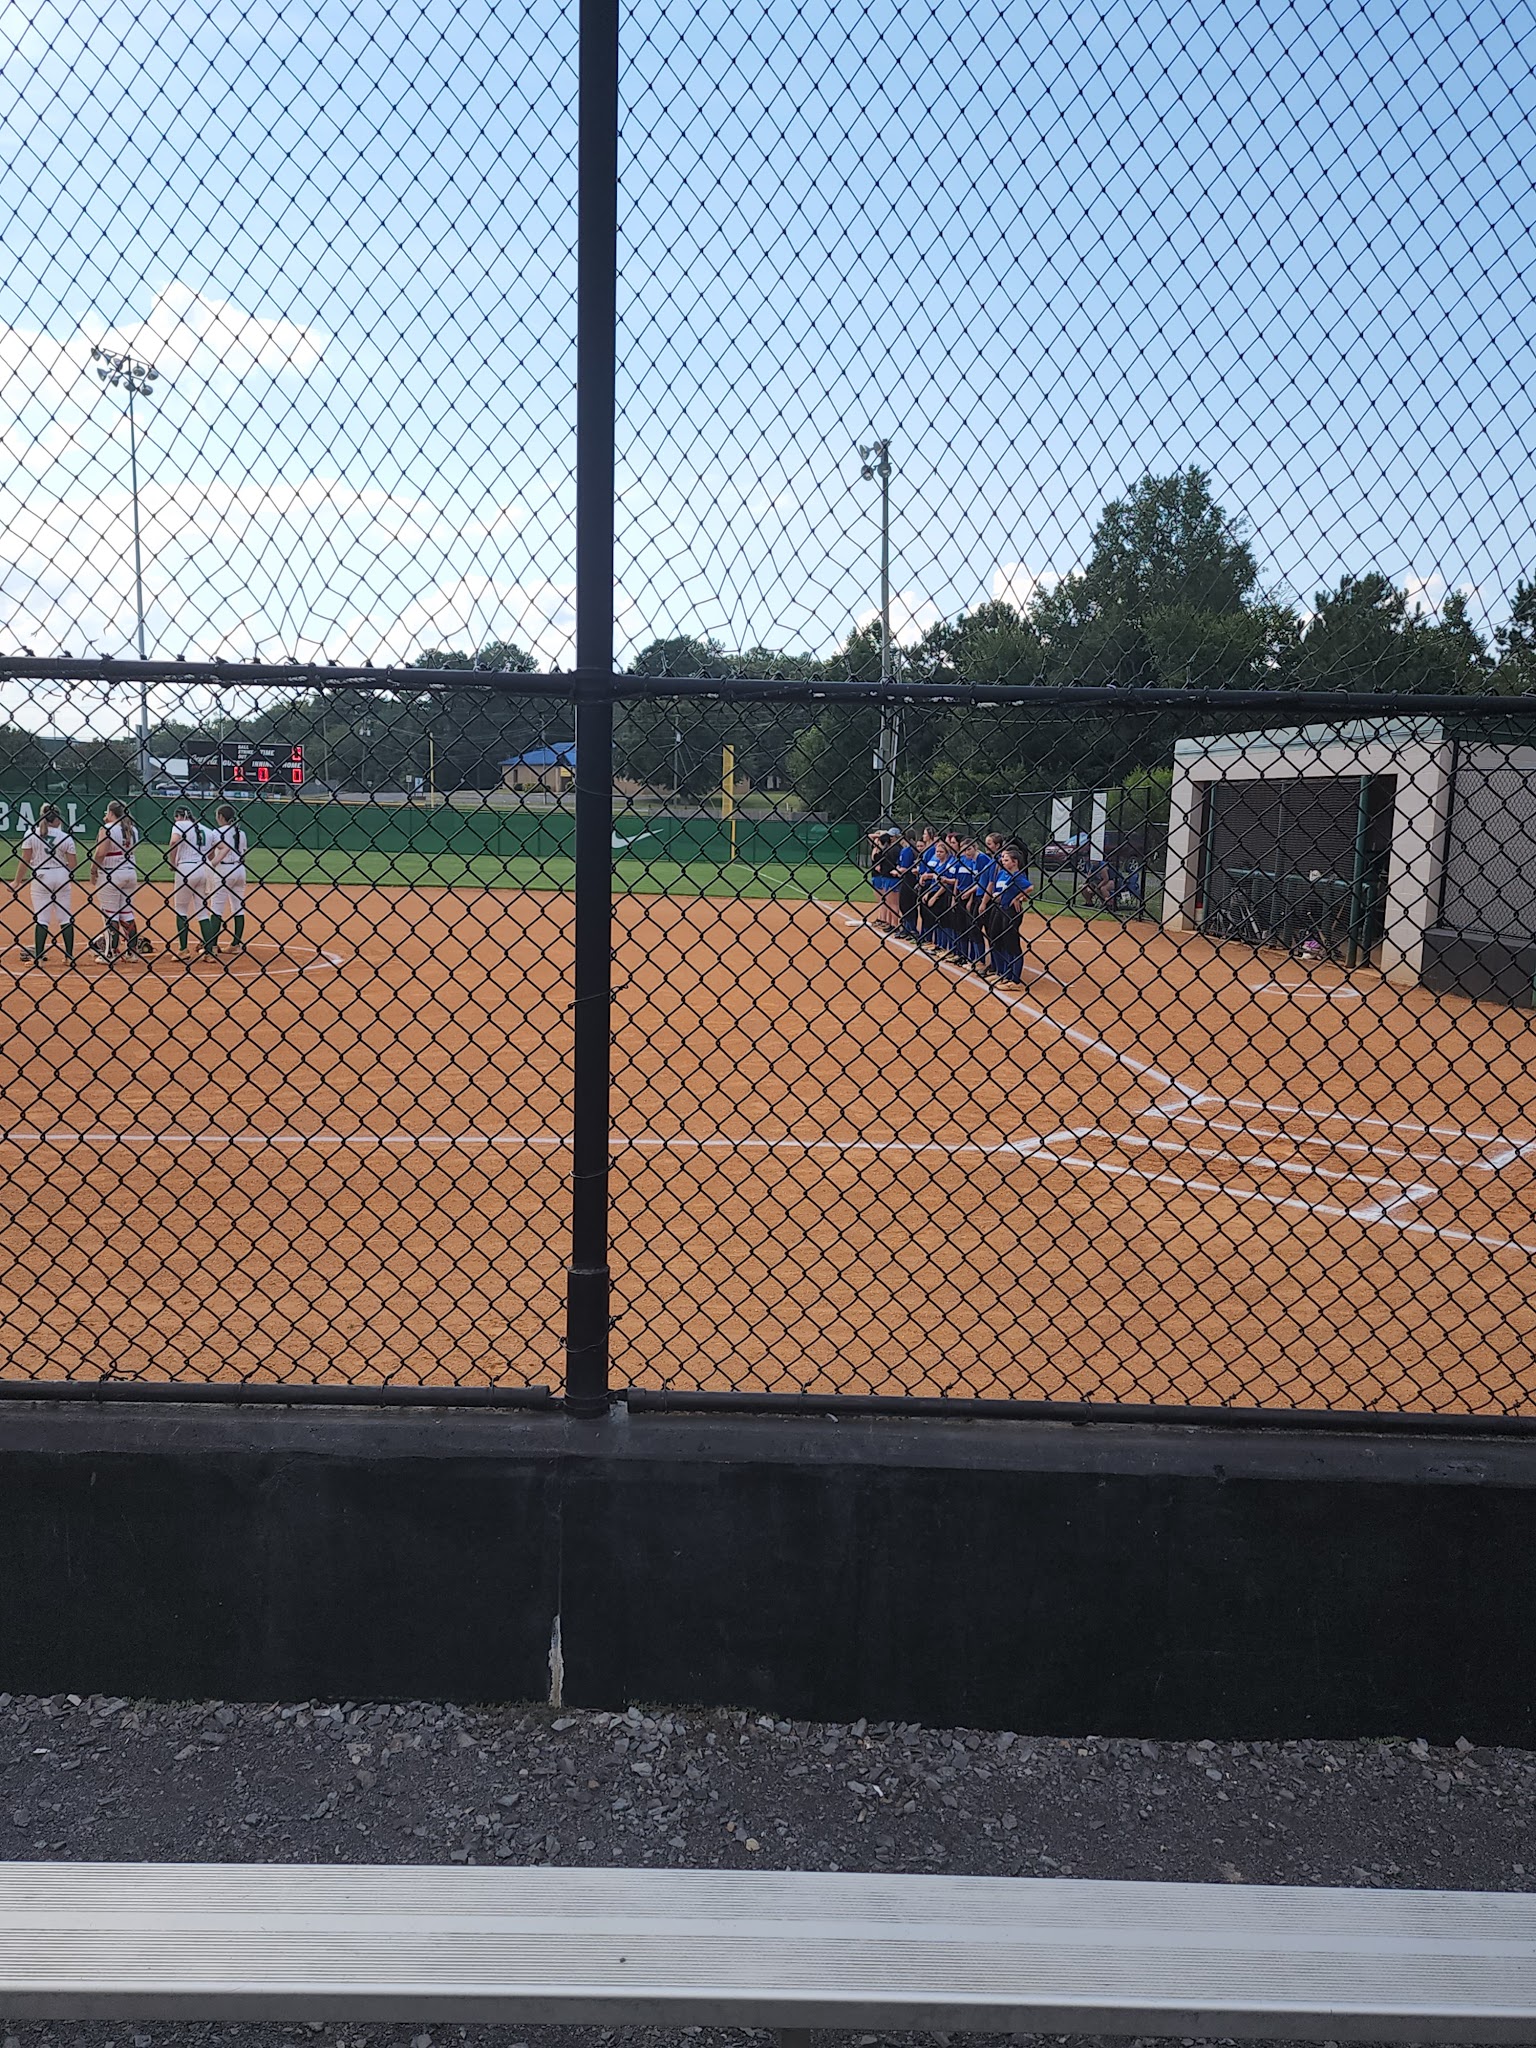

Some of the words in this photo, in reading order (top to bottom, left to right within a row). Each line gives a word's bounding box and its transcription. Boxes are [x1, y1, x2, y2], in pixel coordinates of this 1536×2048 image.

[189, 754, 219, 766] CocaCola
[292, 768, 303, 783] 0
[0, 801, 86, 833] BAL
